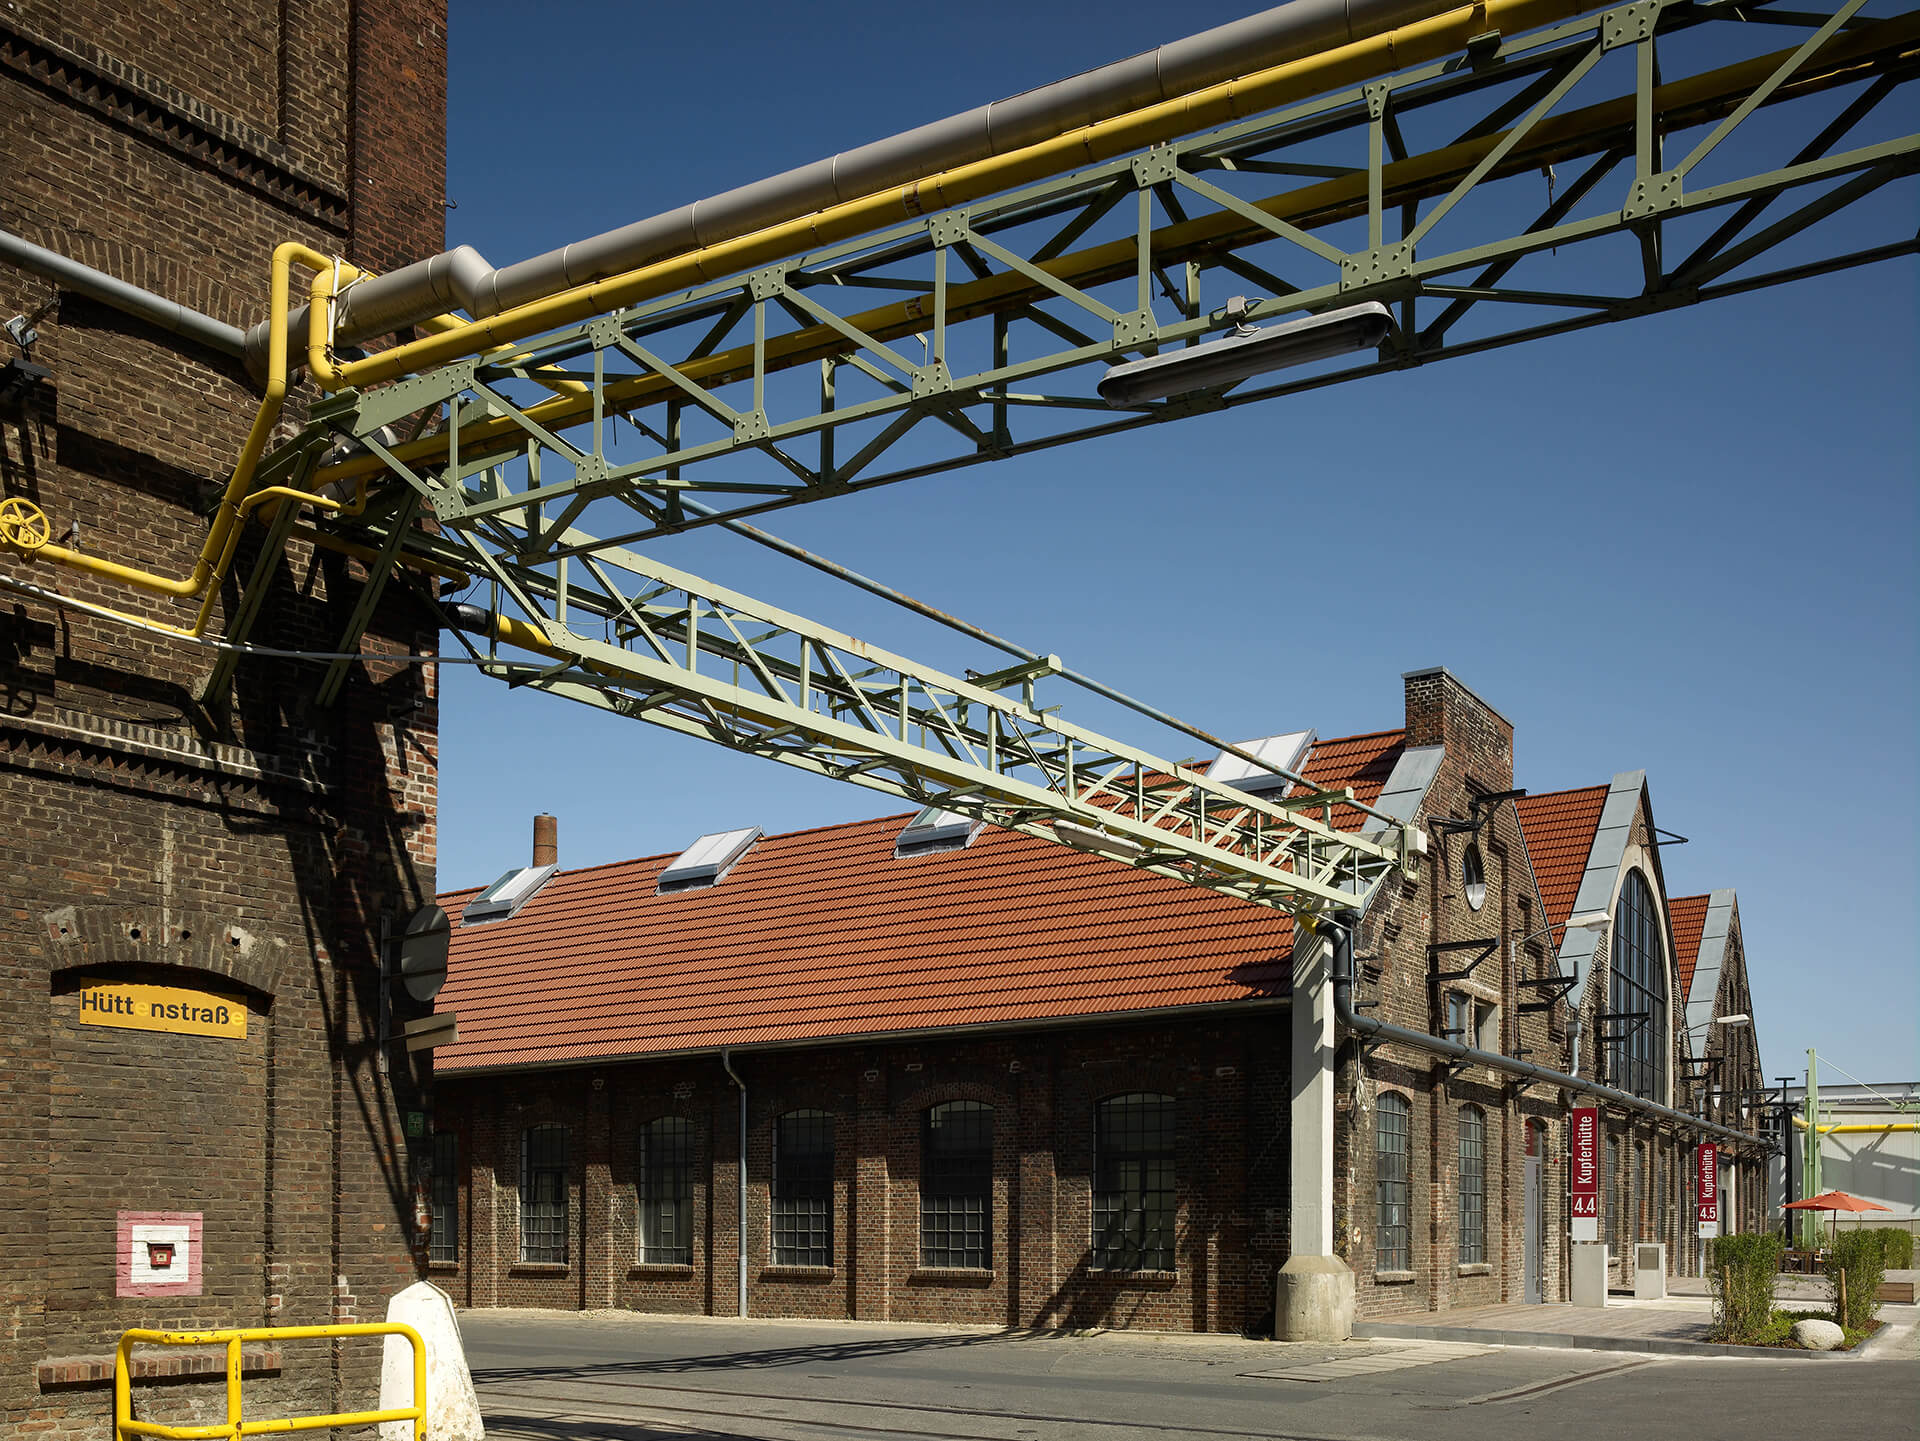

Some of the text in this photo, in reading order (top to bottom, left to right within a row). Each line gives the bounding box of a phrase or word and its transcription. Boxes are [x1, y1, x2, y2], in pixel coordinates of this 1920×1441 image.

[1577, 1116, 1595, 1184] Kupferhütte
[1702, 1149, 1716, 1198] Kupferhütte
[1574, 1196, 1595, 1214] 4.4
[1700, 1206, 1716, 1219] 4.5
